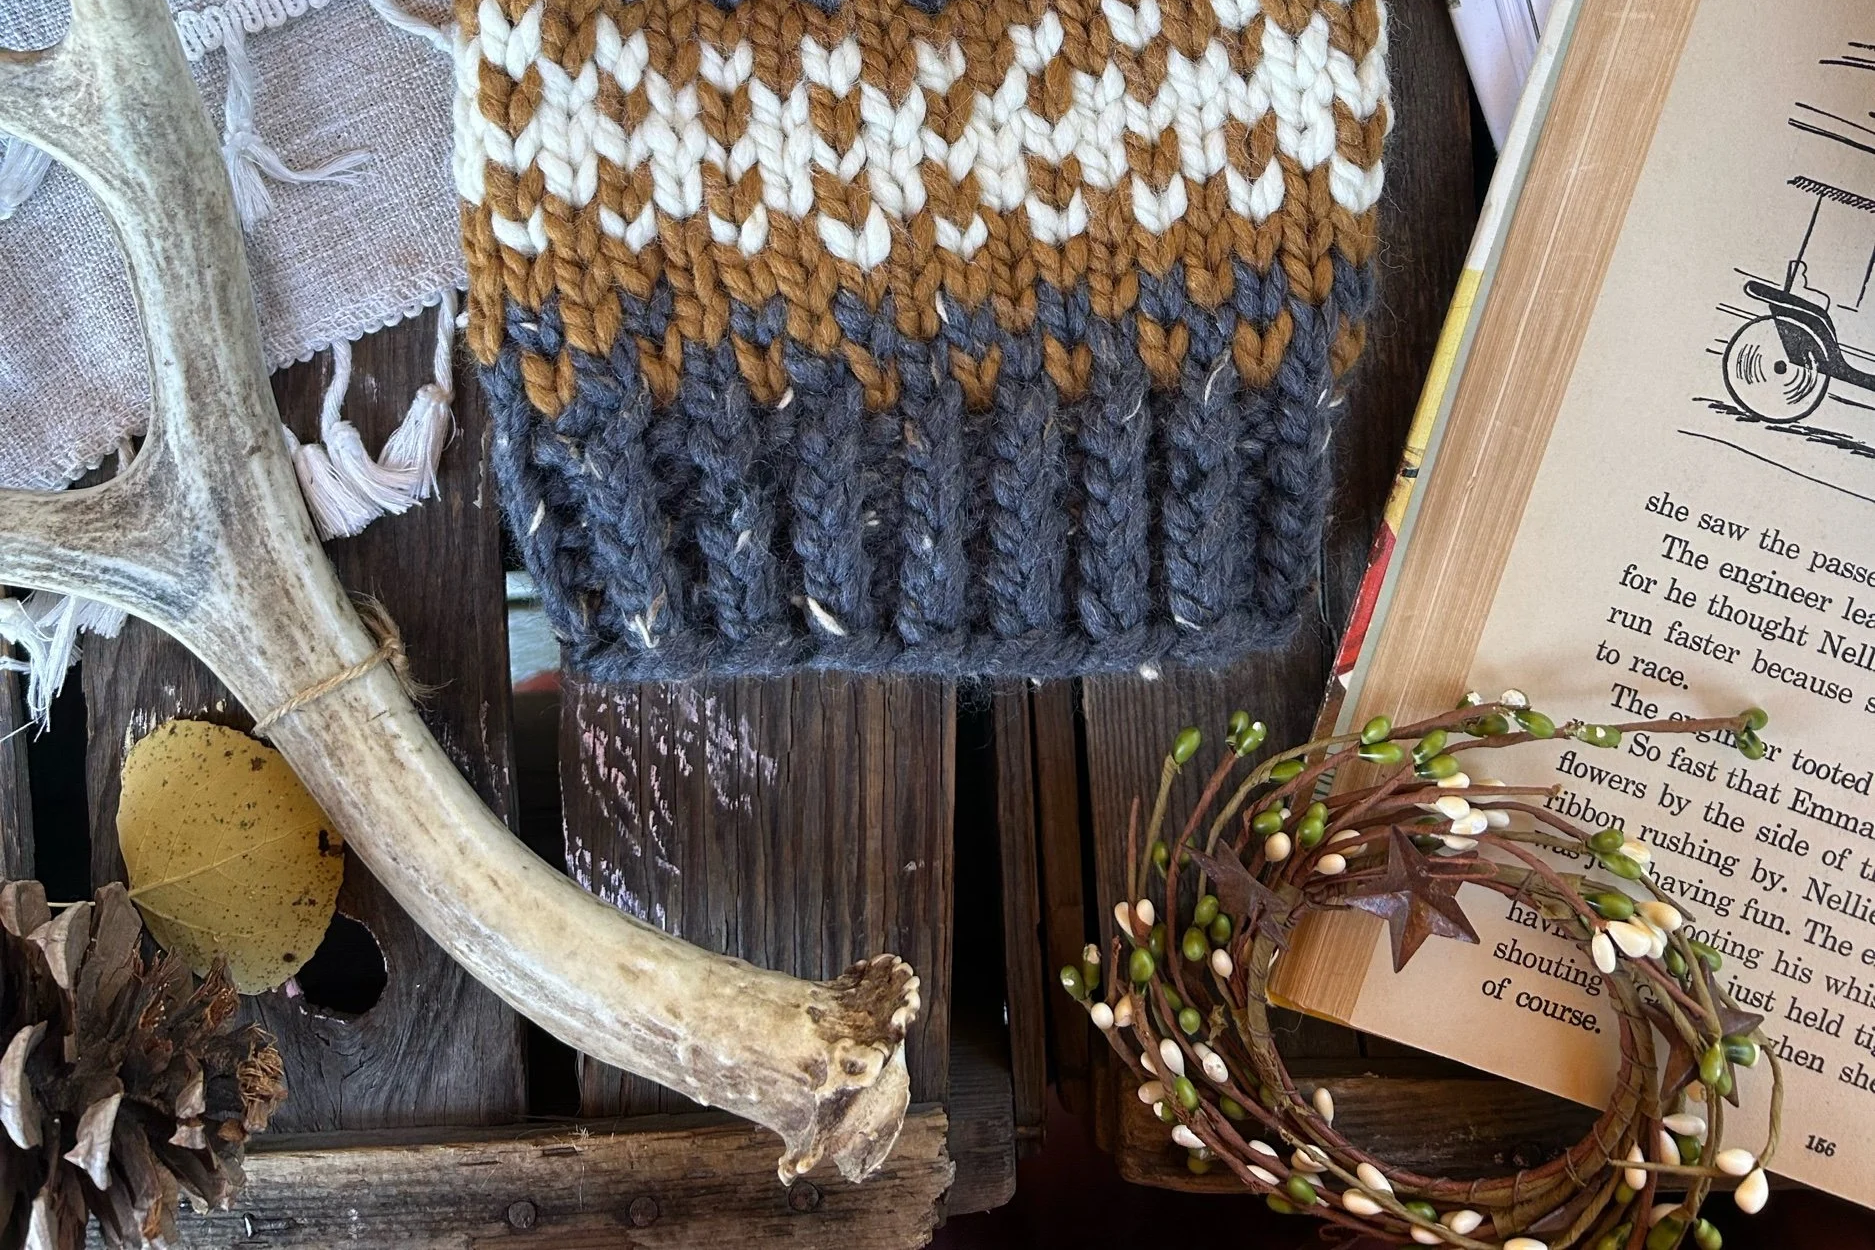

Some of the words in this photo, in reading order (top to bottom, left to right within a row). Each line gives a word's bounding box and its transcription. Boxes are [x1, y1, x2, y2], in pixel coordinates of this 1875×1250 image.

[1645, 491, 1689, 522] she
[1697, 512, 1749, 541] saw
[1758, 527, 1800, 560] the
[1661, 533, 1709, 570] The
[1719, 561, 1833, 613] engineer
[1606, 606, 1653, 636] run
[1664, 620, 1740, 664] faster
[1751, 648, 1853, 704] because
[1619, 563, 1657, 594] for
[1664, 577, 1697, 608] he
[1706, 593, 1809, 647] thought
[1816, 629, 1875, 673] Nell
[1596, 639, 1620, 665] to
[1628, 655, 1689, 690] race.
[1611, 682, 1658, 719] The
[1791, 748, 1874, 796] tooted
[1556, 750, 1648, 799] flowers
[1657, 782, 1692, 817] by
[1703, 801, 1745, 833] the
[1755, 823, 1810, 857] side
[1821, 848, 1853, 871] of
[1628, 732, 1661, 762] So
[1667, 746, 1719, 782] fast
[1725, 767, 1782, 805] that
[1787, 787, 1875, 840] Emma
[1543, 790, 1626, 834] ribbon
[1637, 824, 1740, 877] rushing
[1751, 857, 1788, 893] by.
[1648, 861, 1735, 917] having
[1740, 898, 1791, 936] fun.
[1803, 918, 1853, 957] The
[1493, 938, 1603, 996] shouting
[1683, 923, 1764, 969] ooting
[1771, 949, 1813, 984] his
[1481, 977, 1511, 1000] of
[1515, 991, 1600, 1034] course.
[1784, 996, 1845, 1038] held
[1805, 1134, 1837, 1157] 156
